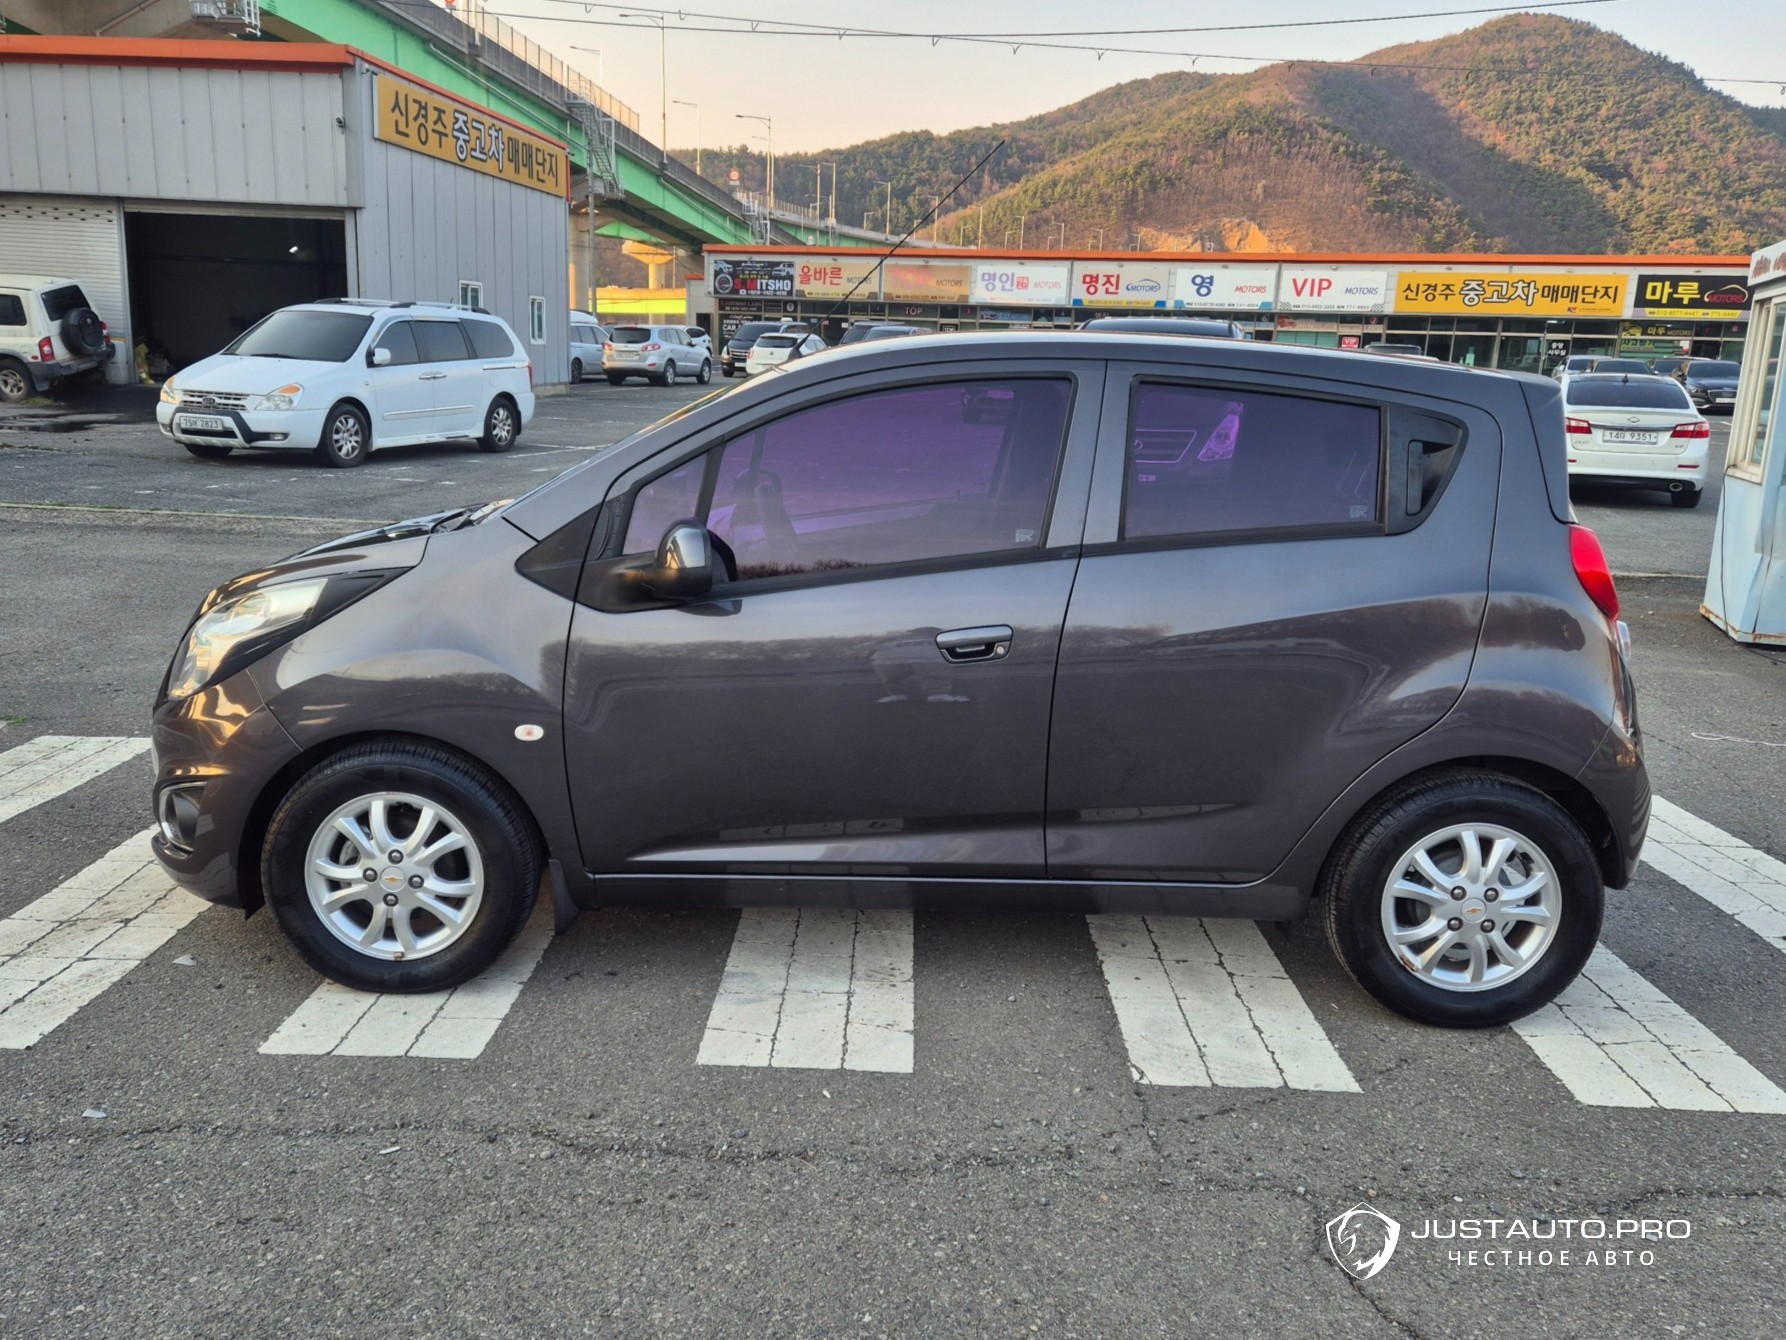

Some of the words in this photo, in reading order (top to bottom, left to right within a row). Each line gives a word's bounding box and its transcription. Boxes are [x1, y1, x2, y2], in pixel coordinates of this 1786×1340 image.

[391, 91, 448, 148] 신경주
[452, 110, 505, 173] 중고차
[507, 137, 558, 187] 매매단지
[798, 265, 843, 286] 올바른
[847, 276, 873, 285] MOTORS
[936, 279, 963, 287] MOTORS
[981, 272, 1015, 292] 명인
[1033, 281, 1061, 289] MOTORS
[1082, 274, 1120, 295] 명진
[1191, 274, 1214, 297] 영
[1235, 285, 1267, 293] MOTORS
[1292, 278, 1332, 297] VIP
[1345, 287, 1378, 295] MOTORS
[1402, 283, 1456, 302] 신경주
[1459, 279, 1538, 306] 중고차
[1541, 285, 1619, 304] 매매단지
[1645, 281, 1701, 304] 마루
[1709, 294, 1744, 303] MOTORS
[905, 307, 923, 315] TOP
[1647, 326, 1666, 335] 마루
[200, 419, 218, 429] 2823
[1630, 432, 1653, 441] 9351
